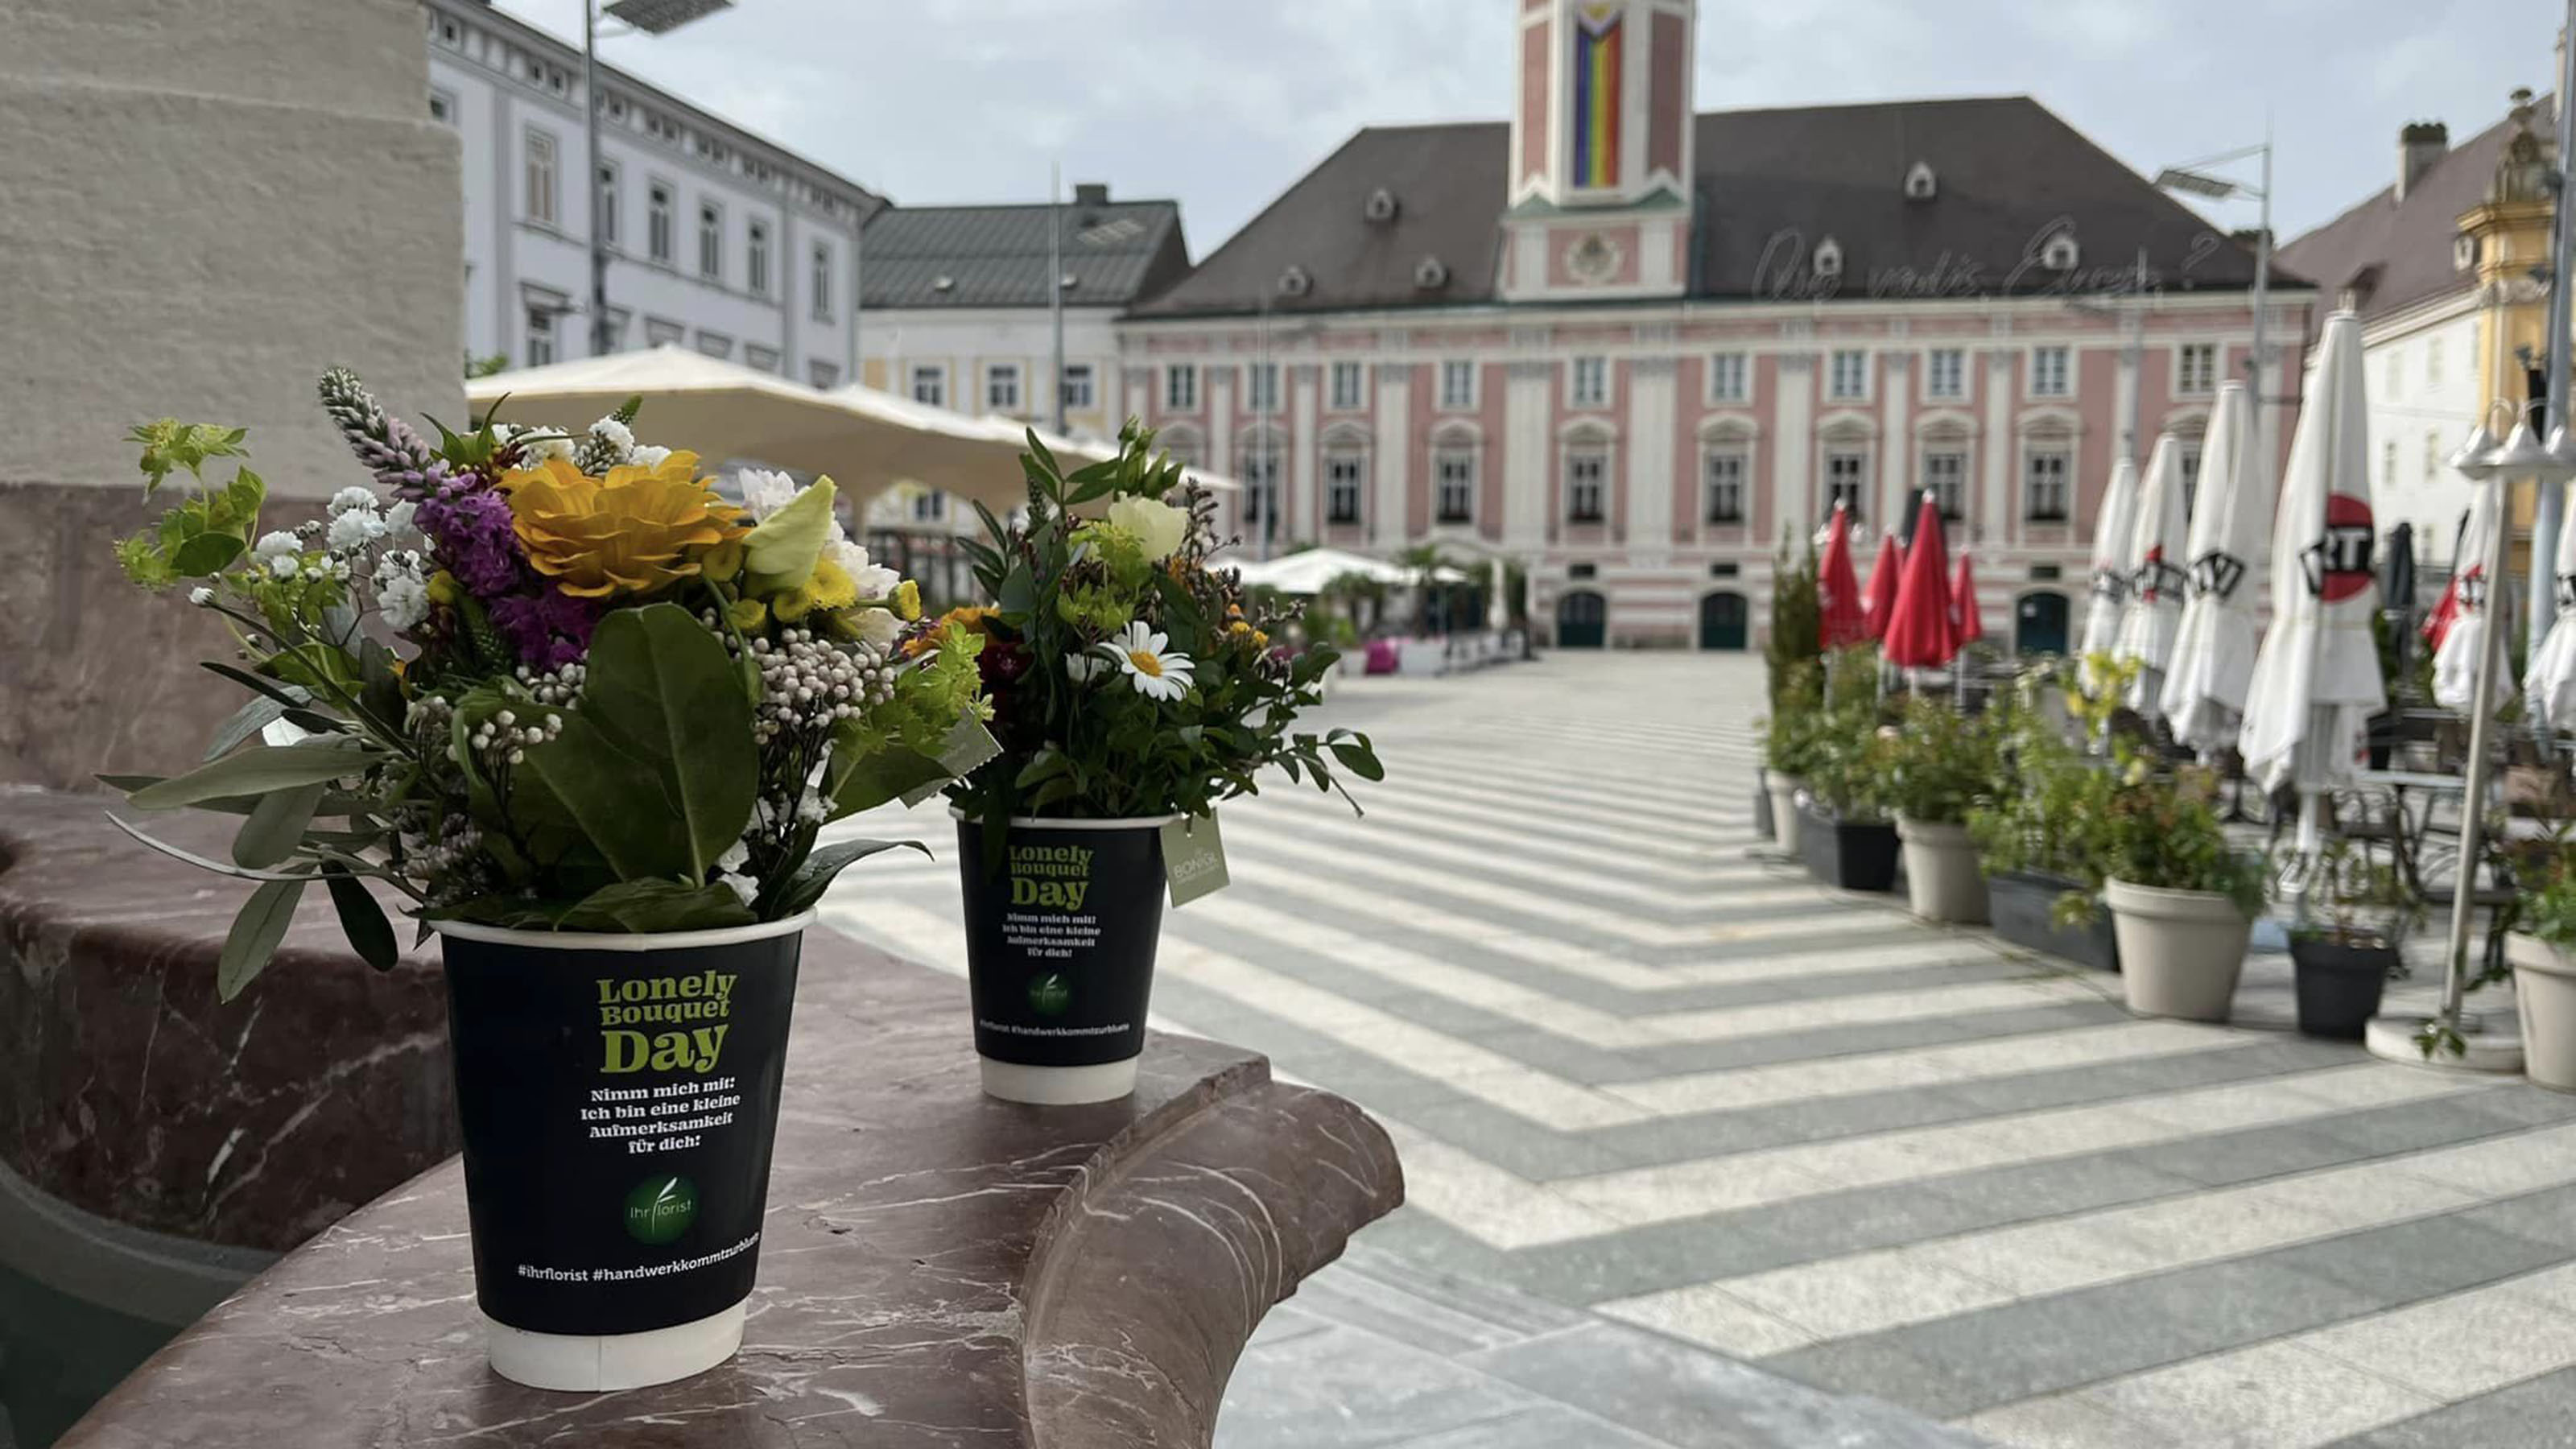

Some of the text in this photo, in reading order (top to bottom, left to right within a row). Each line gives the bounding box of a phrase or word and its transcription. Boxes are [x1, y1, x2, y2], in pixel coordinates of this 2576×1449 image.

[1009, 845, 1094, 866] Lonely
[1011, 862, 1088, 877] Bouquet
[1011, 877, 1088, 910] Day
[1040, 914, 1070, 923] mich
[1038, 926, 1064, 934] eine
[1066, 926, 1101, 935] kleine
[596, 970, 737, 1004] Lonely
[600, 1000, 730, 1026] Bouquet
[600, 1024, 729, 1073] Day
[591, 1088, 649, 1102] Nimm
[653, 1082, 699, 1098] mich
[580, 1094, 741, 1121] Ich bin eine kleine
[589, 1112, 733, 1138] Aufmerksamkeit
[628, 1139, 655, 1154] für
[518, 1264, 588, 1281] #ihrflorist
